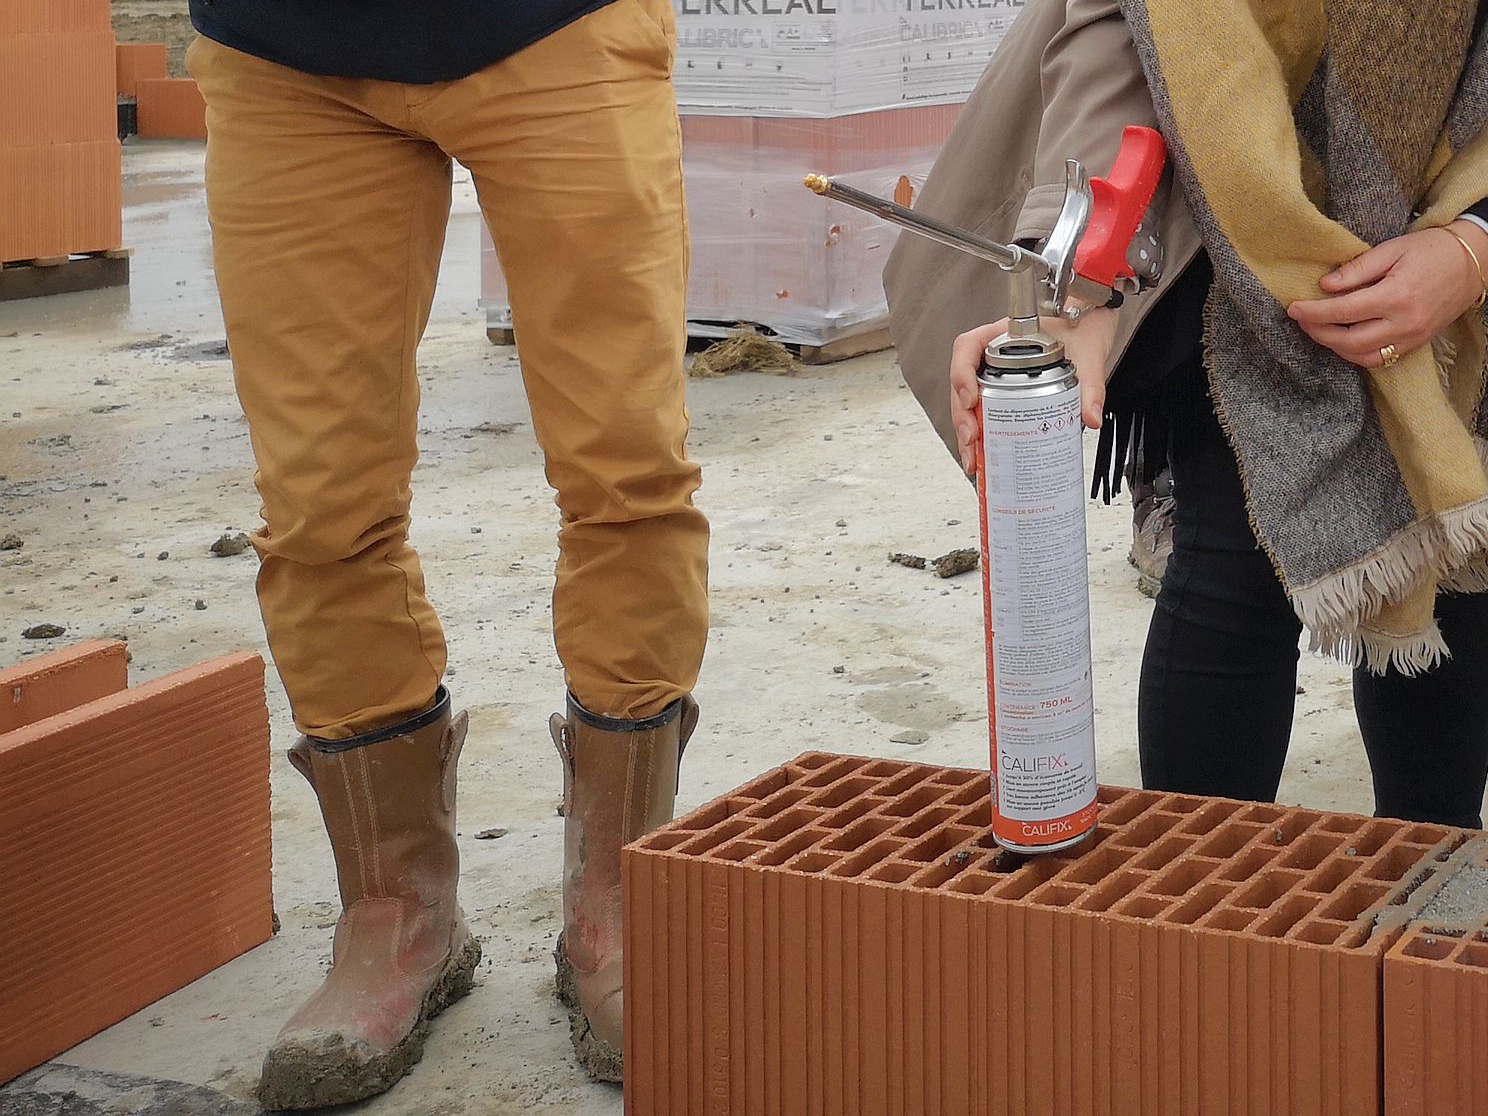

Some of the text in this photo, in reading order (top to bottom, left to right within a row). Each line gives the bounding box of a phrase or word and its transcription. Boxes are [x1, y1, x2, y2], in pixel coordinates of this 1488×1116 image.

[1040, 699, 1058, 709] 750
[1060, 695, 1073, 705] ML
[1002, 753, 1063, 772] CALIFIX
[1022, 822, 1068, 836] CALIFIX
